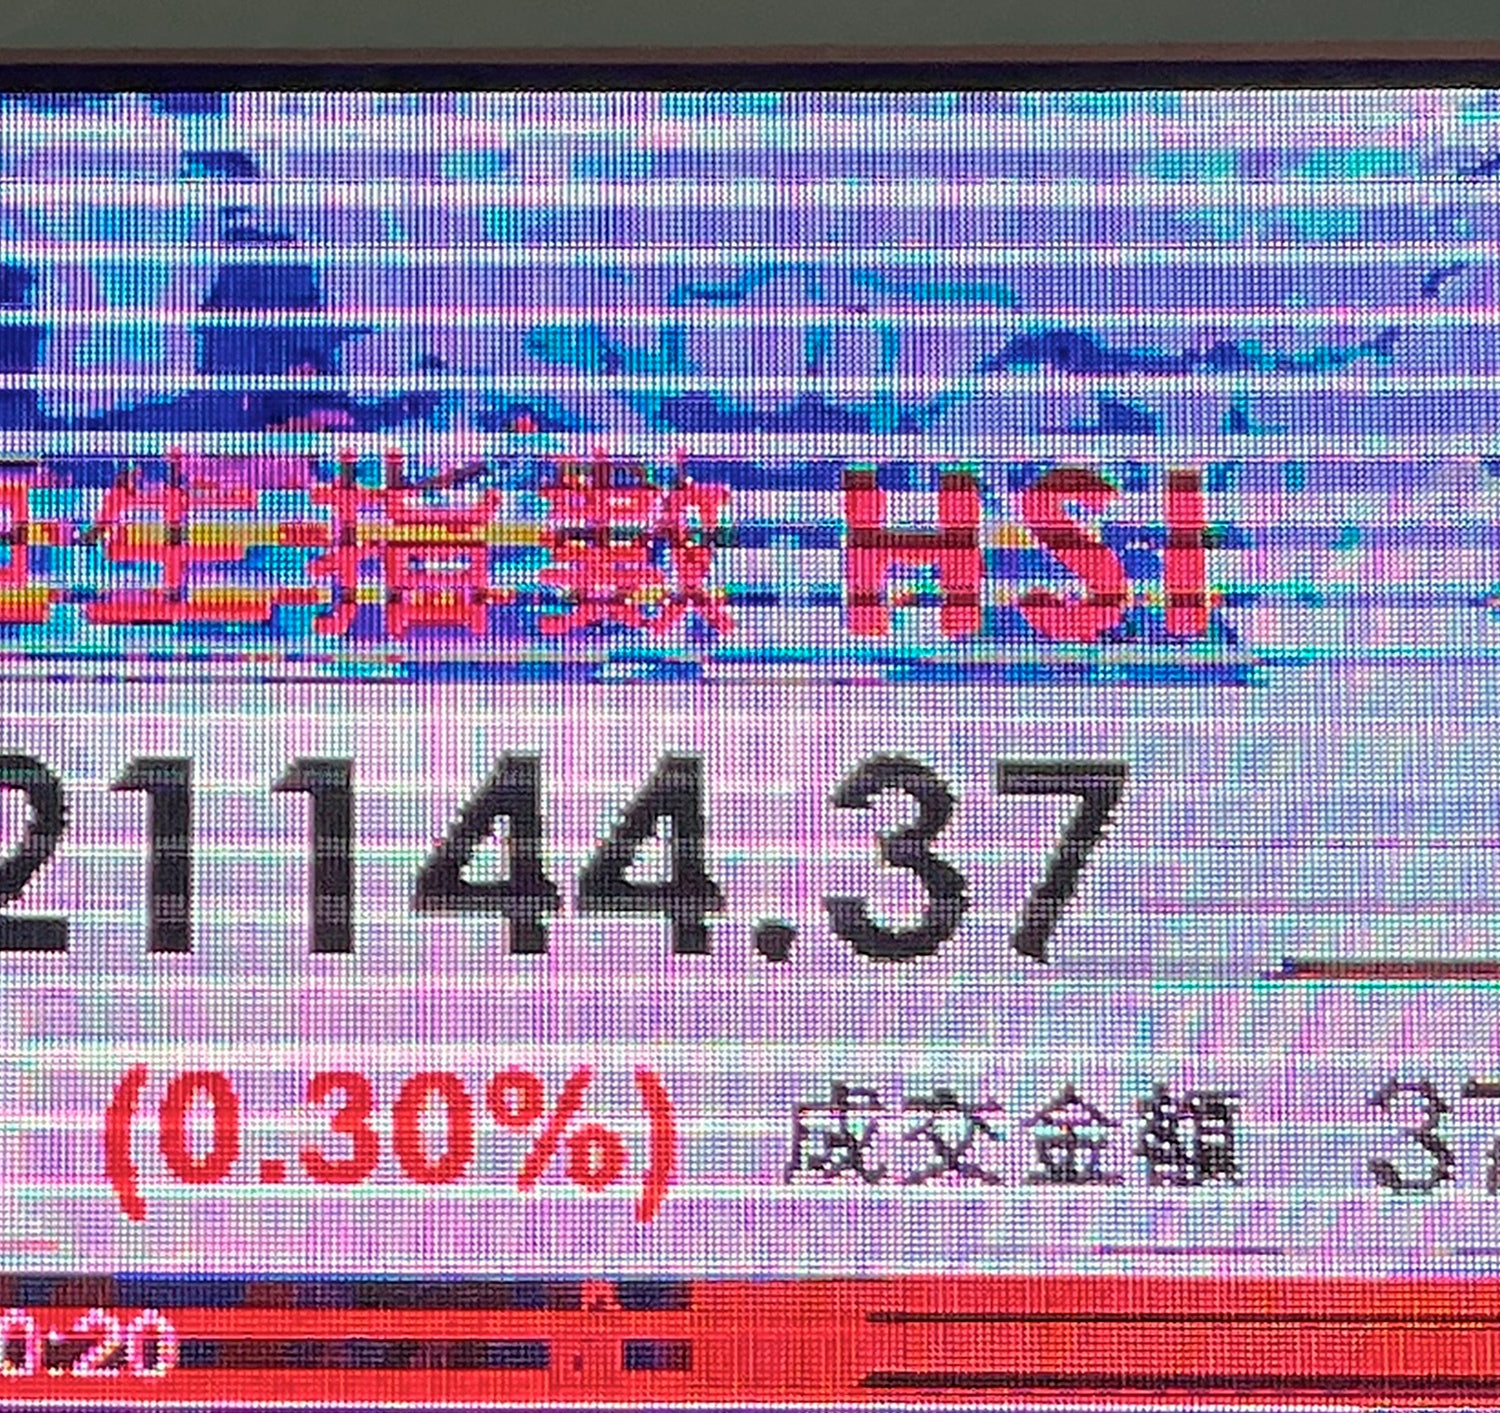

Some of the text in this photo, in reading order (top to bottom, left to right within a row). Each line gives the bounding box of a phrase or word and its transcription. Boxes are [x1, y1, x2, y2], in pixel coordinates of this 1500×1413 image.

[841, 466, 1216, 637] HSI
[104, 1064, 675, 1221] (0.30%)
[783, 1080, 1243, 1189] 成交金額
